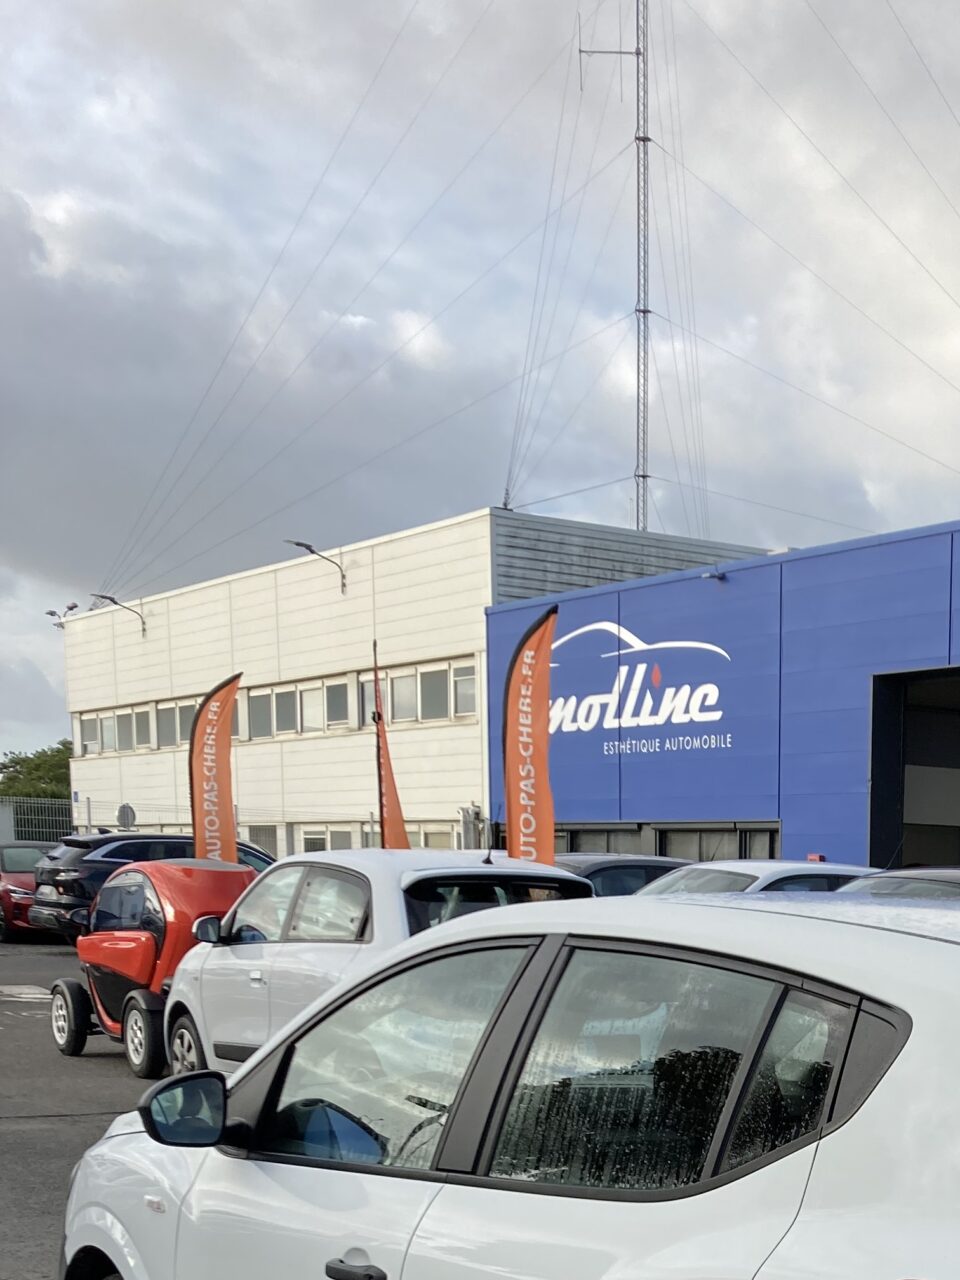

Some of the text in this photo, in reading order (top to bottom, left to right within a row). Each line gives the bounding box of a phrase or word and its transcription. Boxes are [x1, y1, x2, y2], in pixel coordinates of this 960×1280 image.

[518, 649, 537, 862] UTO-PAS-CHERE.FR
[604, 733, 732, 755] ESTHÉTIQUE AUTOMOBILE
